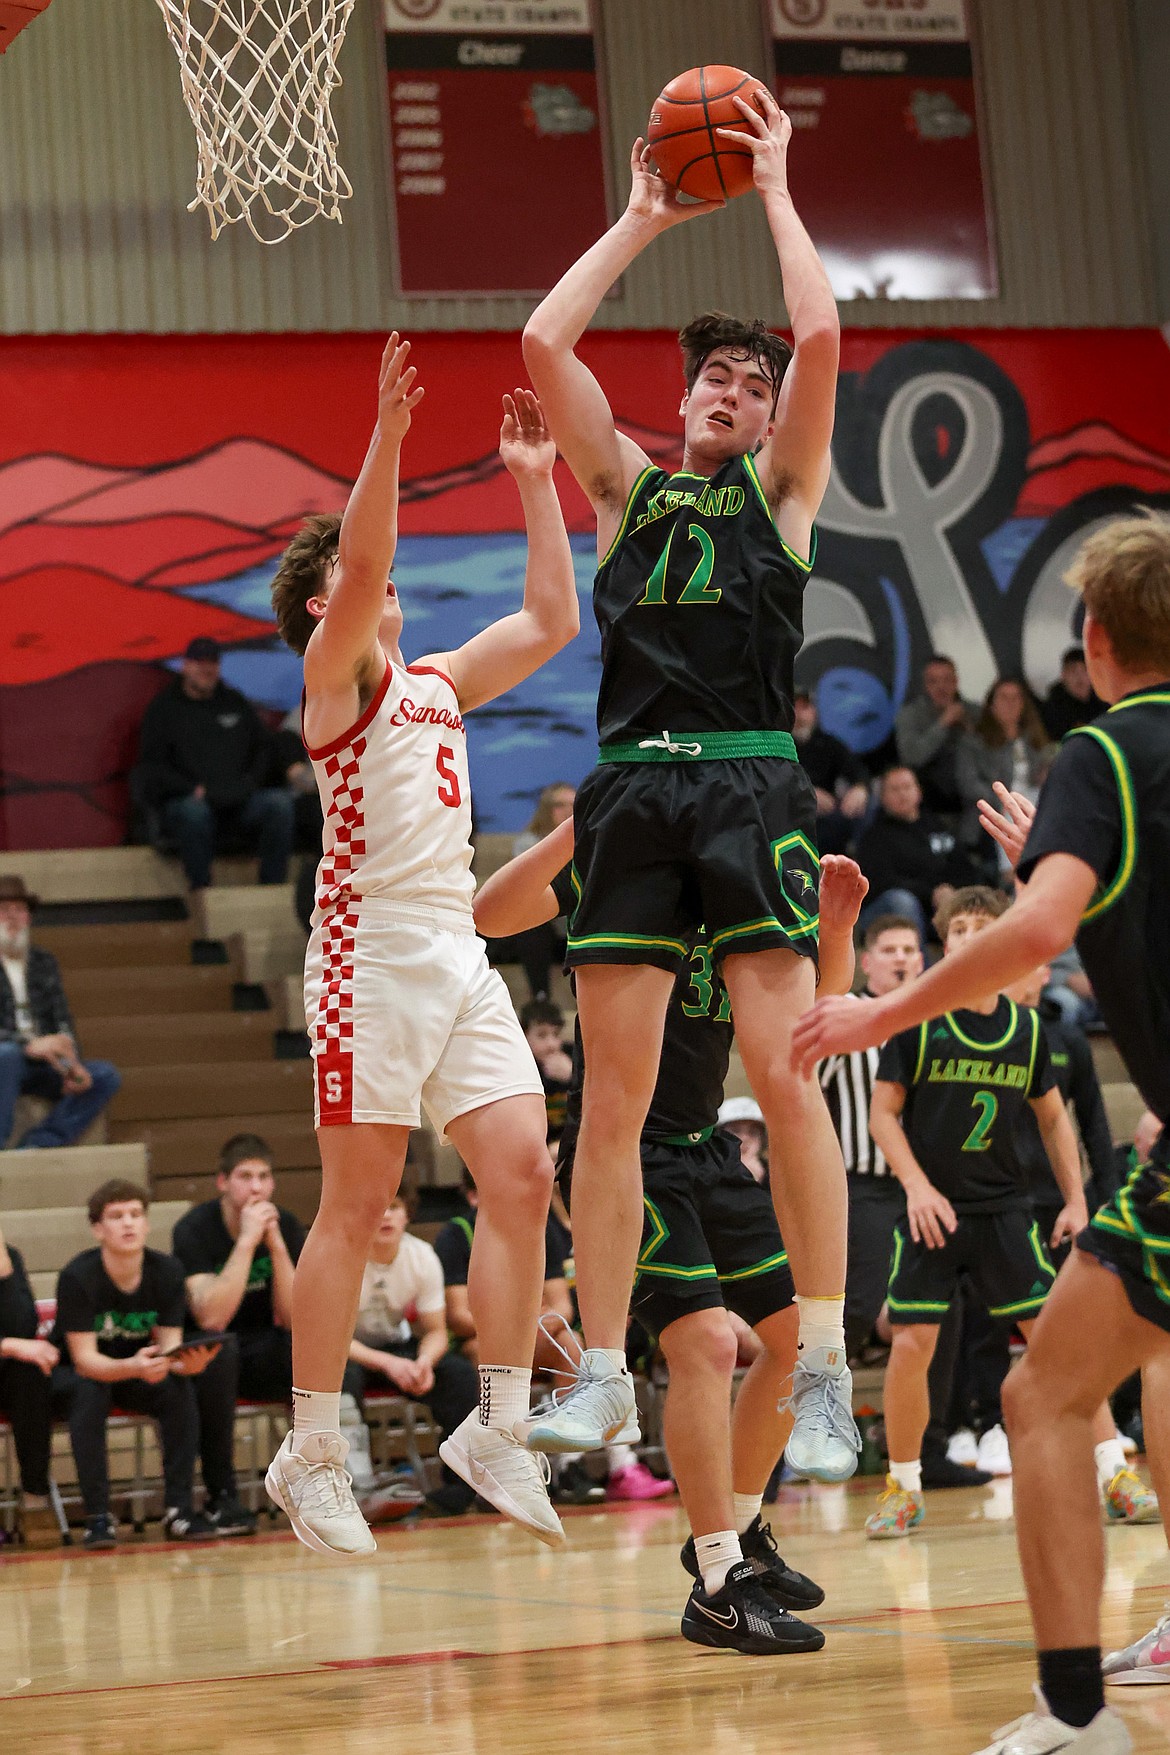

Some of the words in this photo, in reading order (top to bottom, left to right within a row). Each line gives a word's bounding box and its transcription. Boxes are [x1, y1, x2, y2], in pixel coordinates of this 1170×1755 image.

[628, 484, 745, 537] KELAND
[636, 522, 722, 605] 12
[436, 743, 462, 808] 5
[325, 1071, 342, 1103] S
[927, 1058, 1028, 1089] LAKELAND
[961, 1090, 999, 1151] 2
